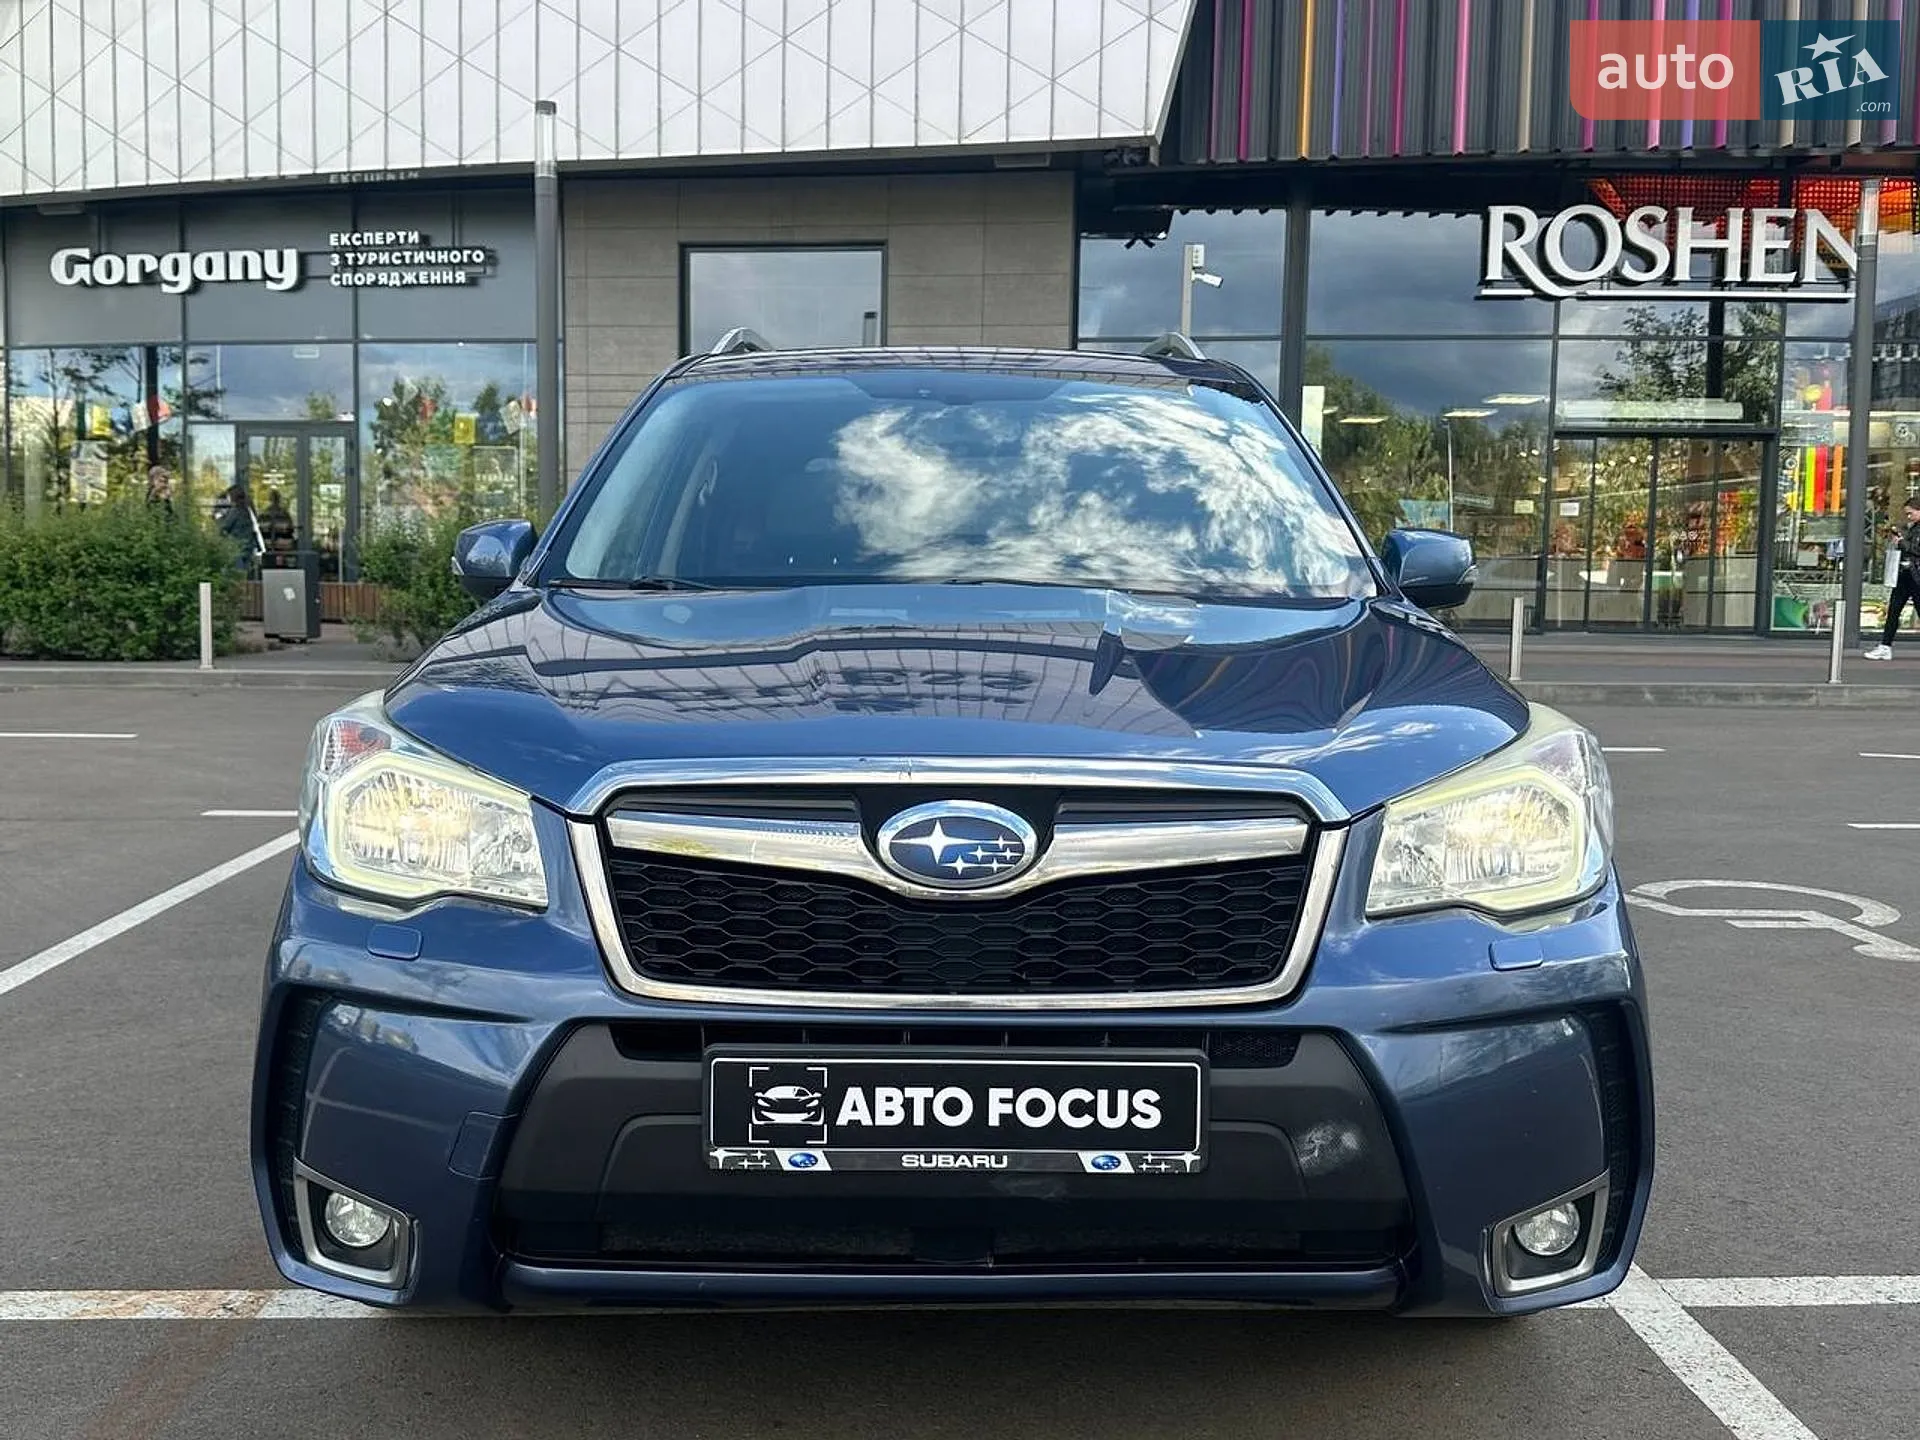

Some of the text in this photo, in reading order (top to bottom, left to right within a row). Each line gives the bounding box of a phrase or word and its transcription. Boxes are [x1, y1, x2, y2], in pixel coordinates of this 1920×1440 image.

[329, 230, 420, 246] ЕКСПЕРТИ
[344, 249, 485, 266] ТУРИСТИЧНОГО
[1484, 203, 1857, 298] ROSHEN
[50, 247, 298, 294] Gorgany
[330, 270, 467, 287] СПОРЯДЖЕННЯ
[835, 1086, 1162, 1129] АВТО FOCUS
[901, 1153, 1009, 1169] SUBARU
